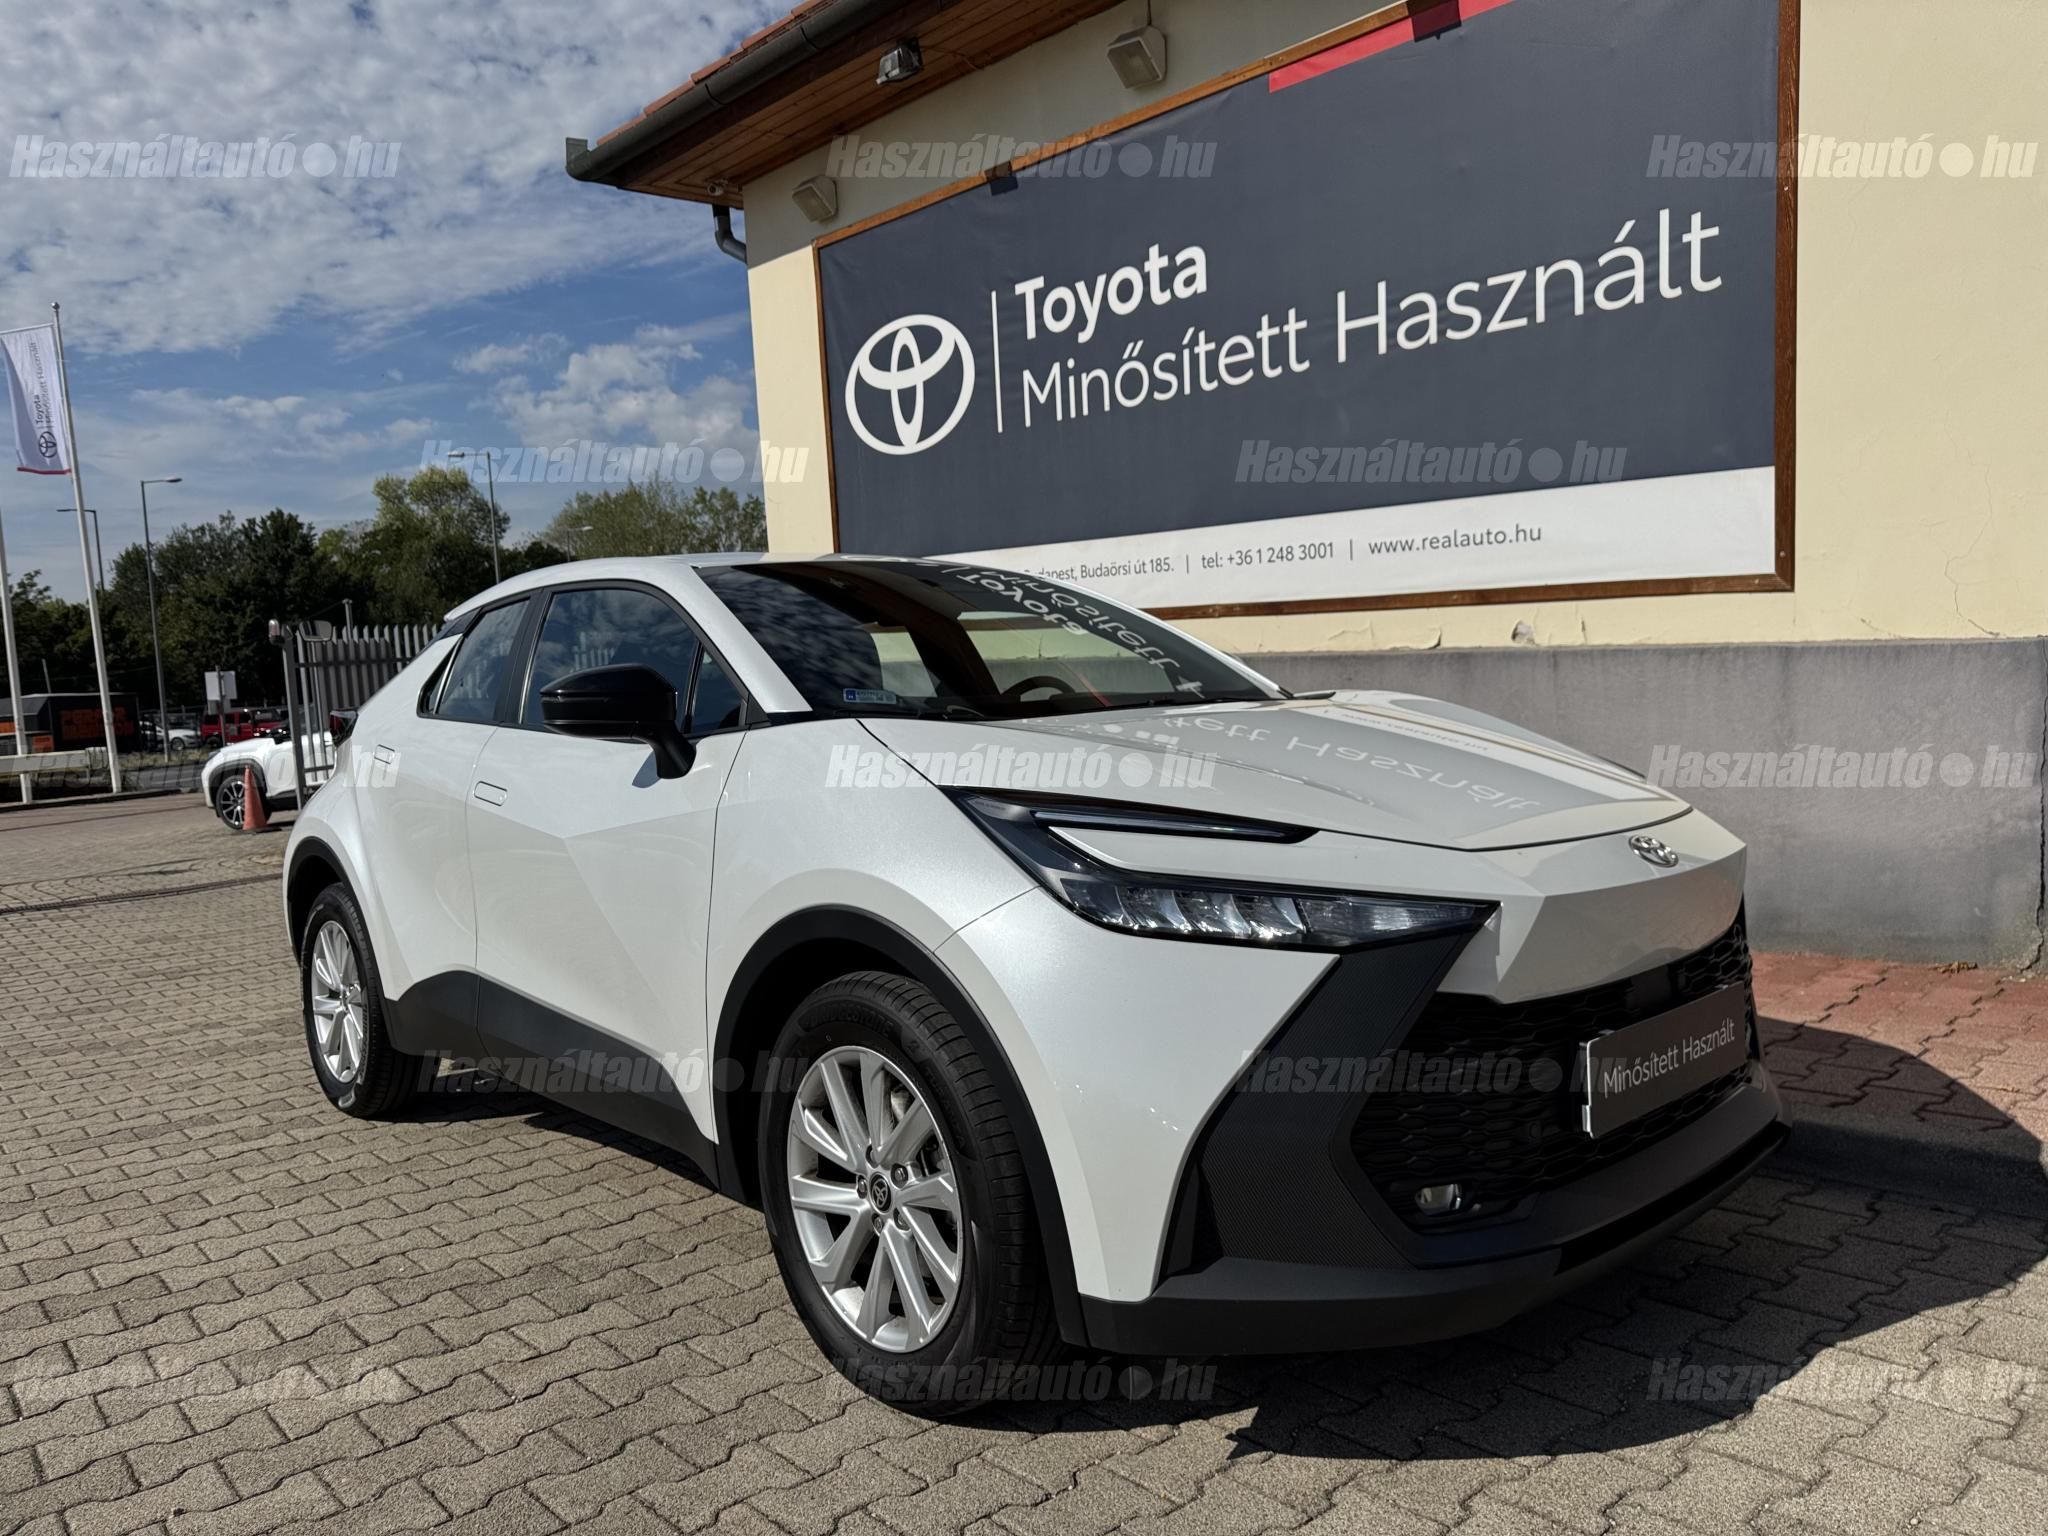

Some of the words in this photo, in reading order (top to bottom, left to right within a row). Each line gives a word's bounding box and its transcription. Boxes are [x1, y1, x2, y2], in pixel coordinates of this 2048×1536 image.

[1014, 244, 1207, 344] Toyota
[1022, 308, 1310, 428] Minősített
[1337, 208, 1722, 363] Használt
[33, 394, 45, 425] Toyota
[1080, 559, 1131, 579] Budaörsi
[1134, 558, 1147, 575] út
[1150, 556, 1175, 573] 185.
[1201, 552, 1224, 569] tel:
[1299, 541, 1334, 560] 3001
[1368, 522, 1543, 555] www.realauto.hu
[1603, 1044, 1679, 1099] Minősített
[1682, 1017, 1735, 1065] Használt
